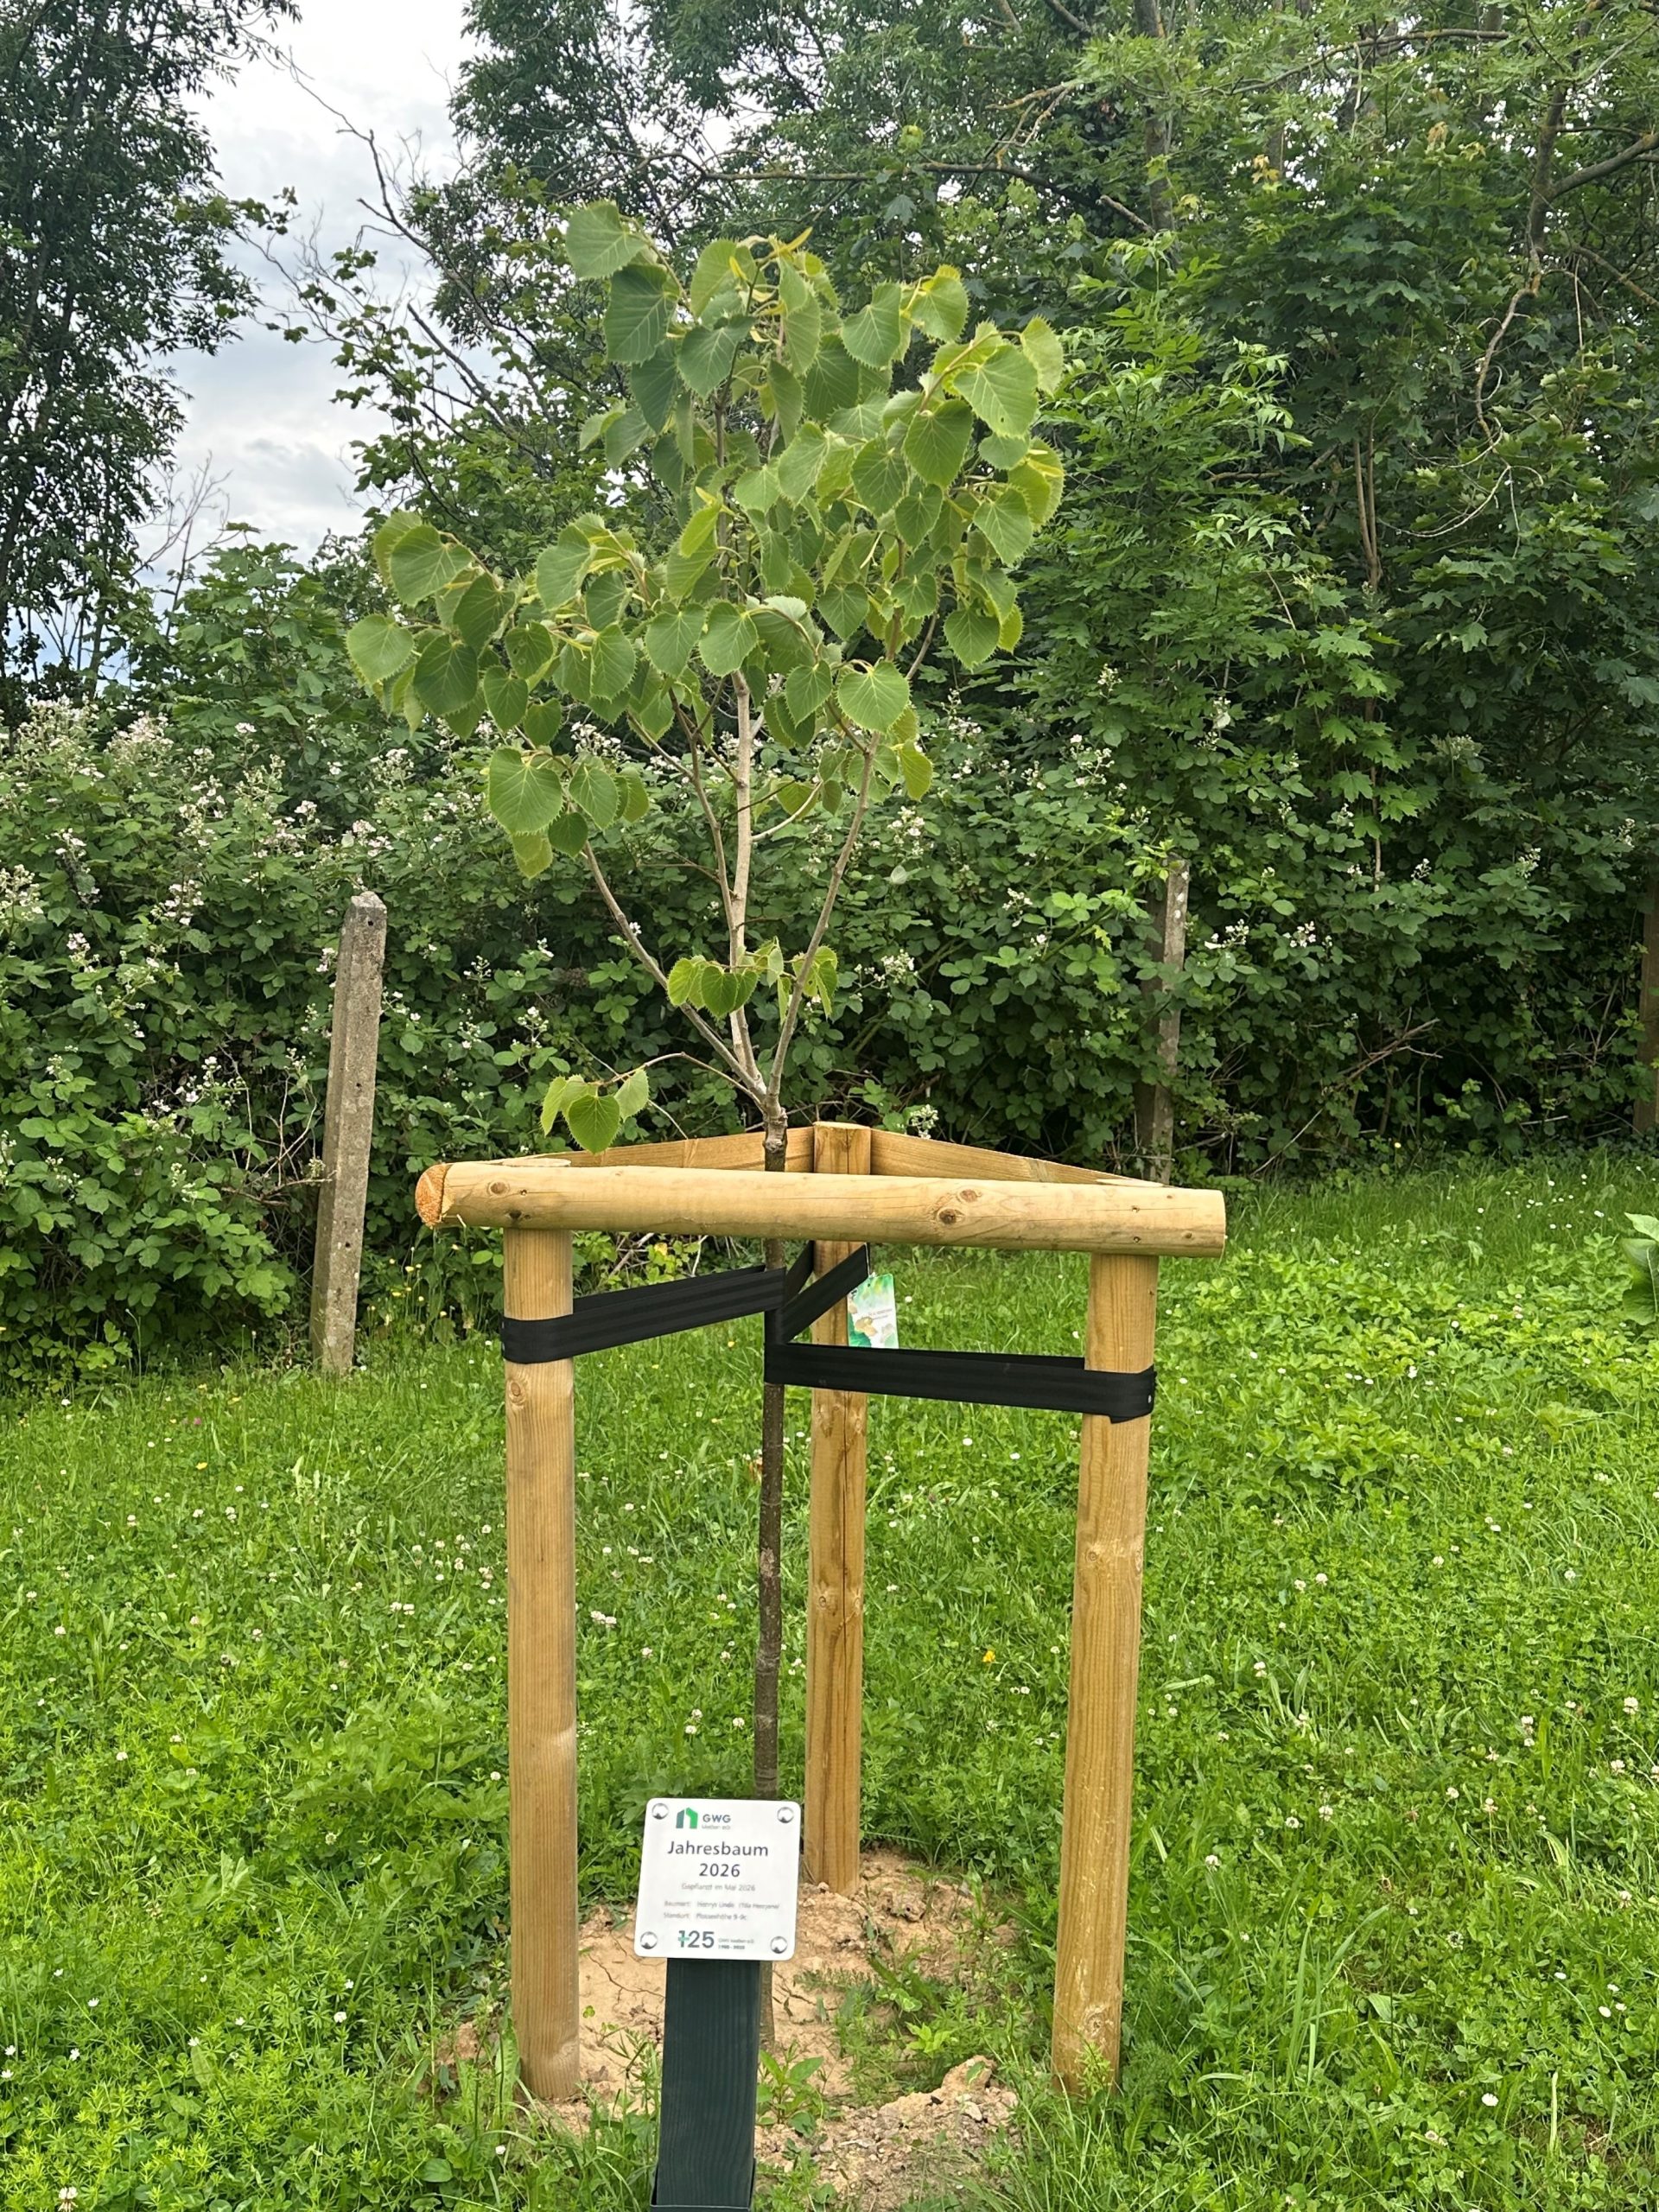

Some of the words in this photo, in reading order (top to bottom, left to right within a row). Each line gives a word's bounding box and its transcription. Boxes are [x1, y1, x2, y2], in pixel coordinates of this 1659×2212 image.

[702, 1814, 731, 1823] GWG
[667, 1840, 769, 1857] Jahresbaum
[699, 1863, 741, 1878] 2026
[678, 1930, 715, 1948] 125
